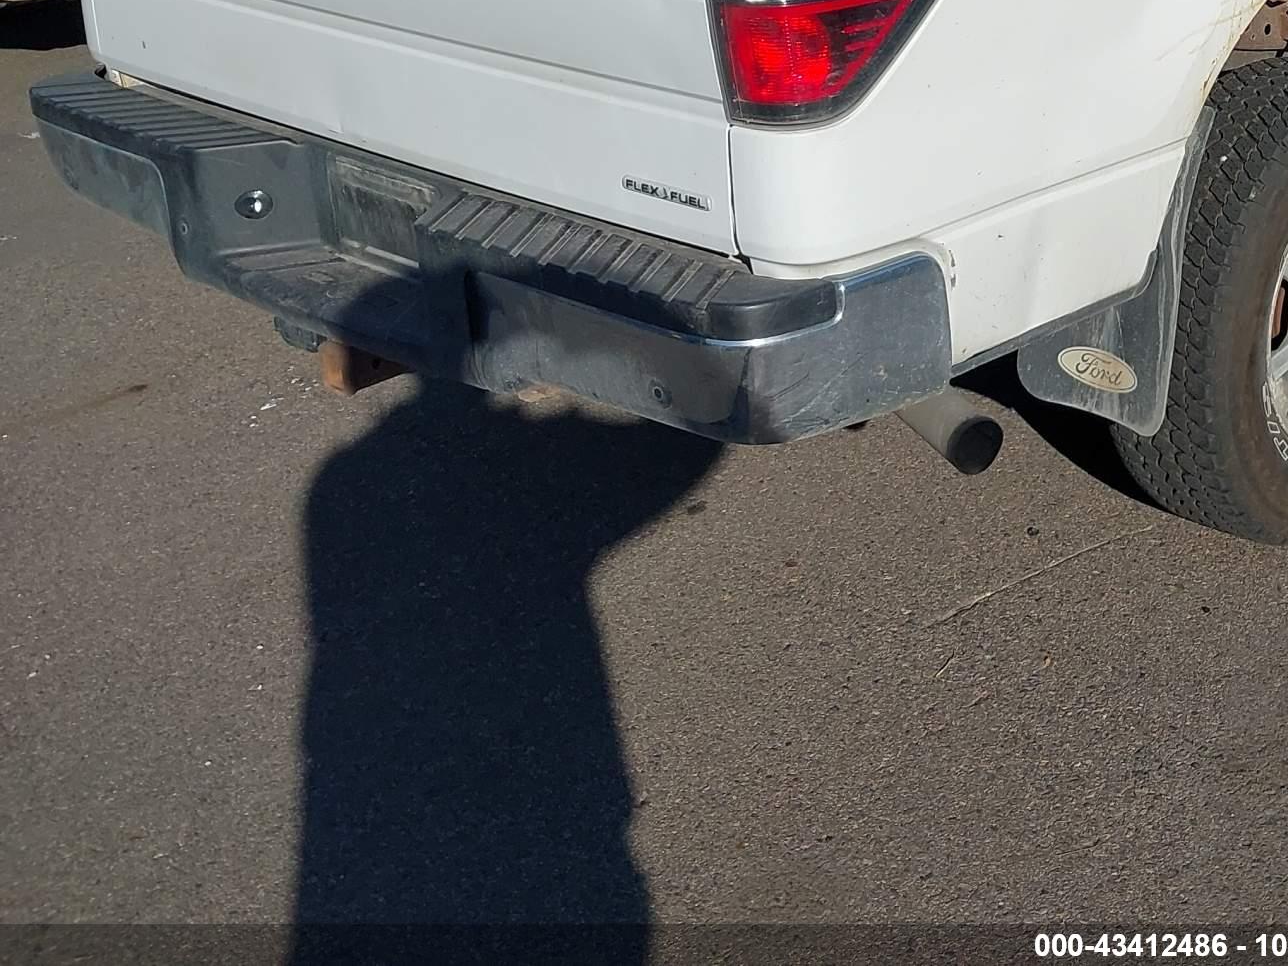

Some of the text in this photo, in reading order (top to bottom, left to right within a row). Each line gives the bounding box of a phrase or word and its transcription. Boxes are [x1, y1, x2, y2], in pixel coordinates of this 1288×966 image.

[625, 178, 706, 210] FLEX FUEL
[1075, 352, 1123, 387] Ford
